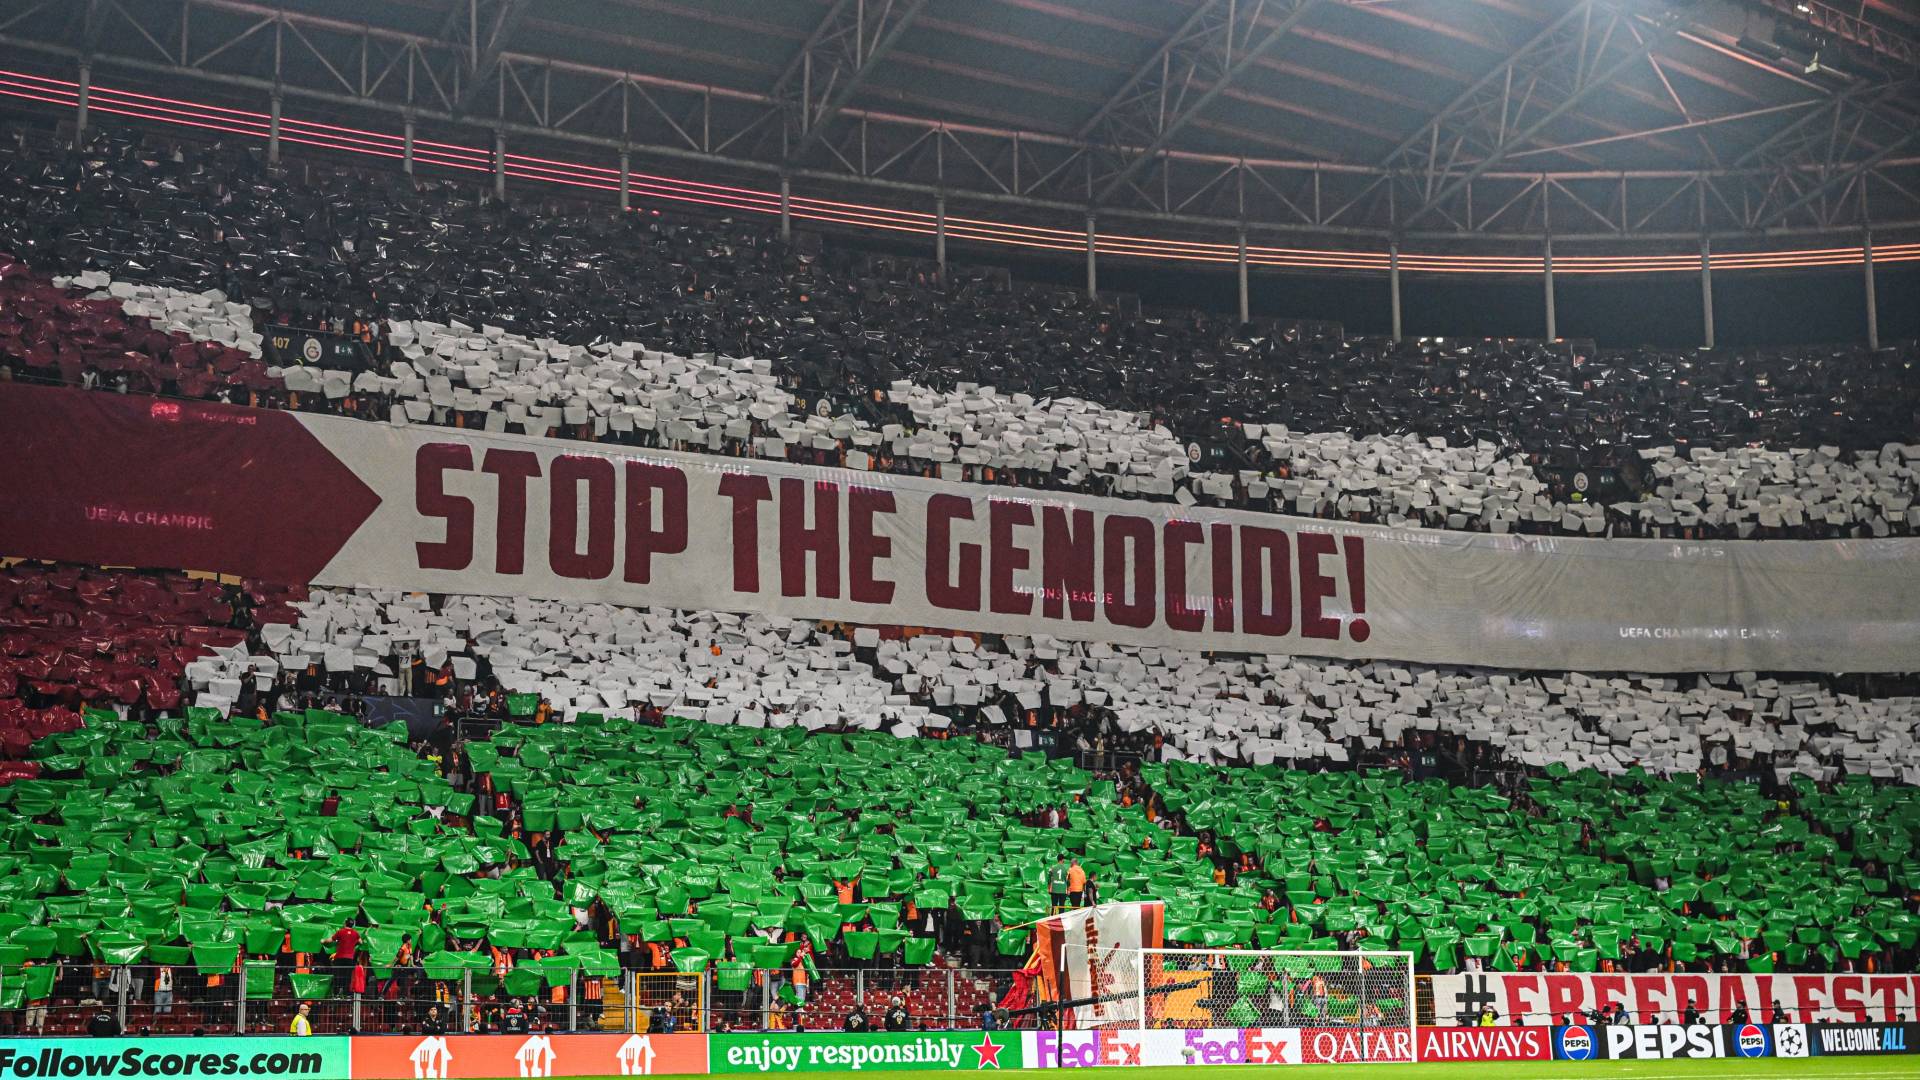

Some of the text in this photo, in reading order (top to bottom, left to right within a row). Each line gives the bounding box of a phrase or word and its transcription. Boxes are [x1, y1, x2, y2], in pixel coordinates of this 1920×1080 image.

[416, 443, 1370, 643] STOP THE GENOCIDE!
[727, 1038, 964, 1071] enjoy responsibly
[1037, 1029, 1140, 1068] FedEx
[1185, 1028, 1287, 1064] FedEx
[1314, 1030, 1540, 1063] QATAR AIRWAYS
[1565, 1040, 1590, 1048] PEPSI
[1606, 1024, 1726, 1060] PEPSI
[1741, 1037, 1763, 1046] PEPSI
[1821, 1027, 1906, 1052] WELCOME ALL
[0, 1048, 322, 1077] FollowScores.com
